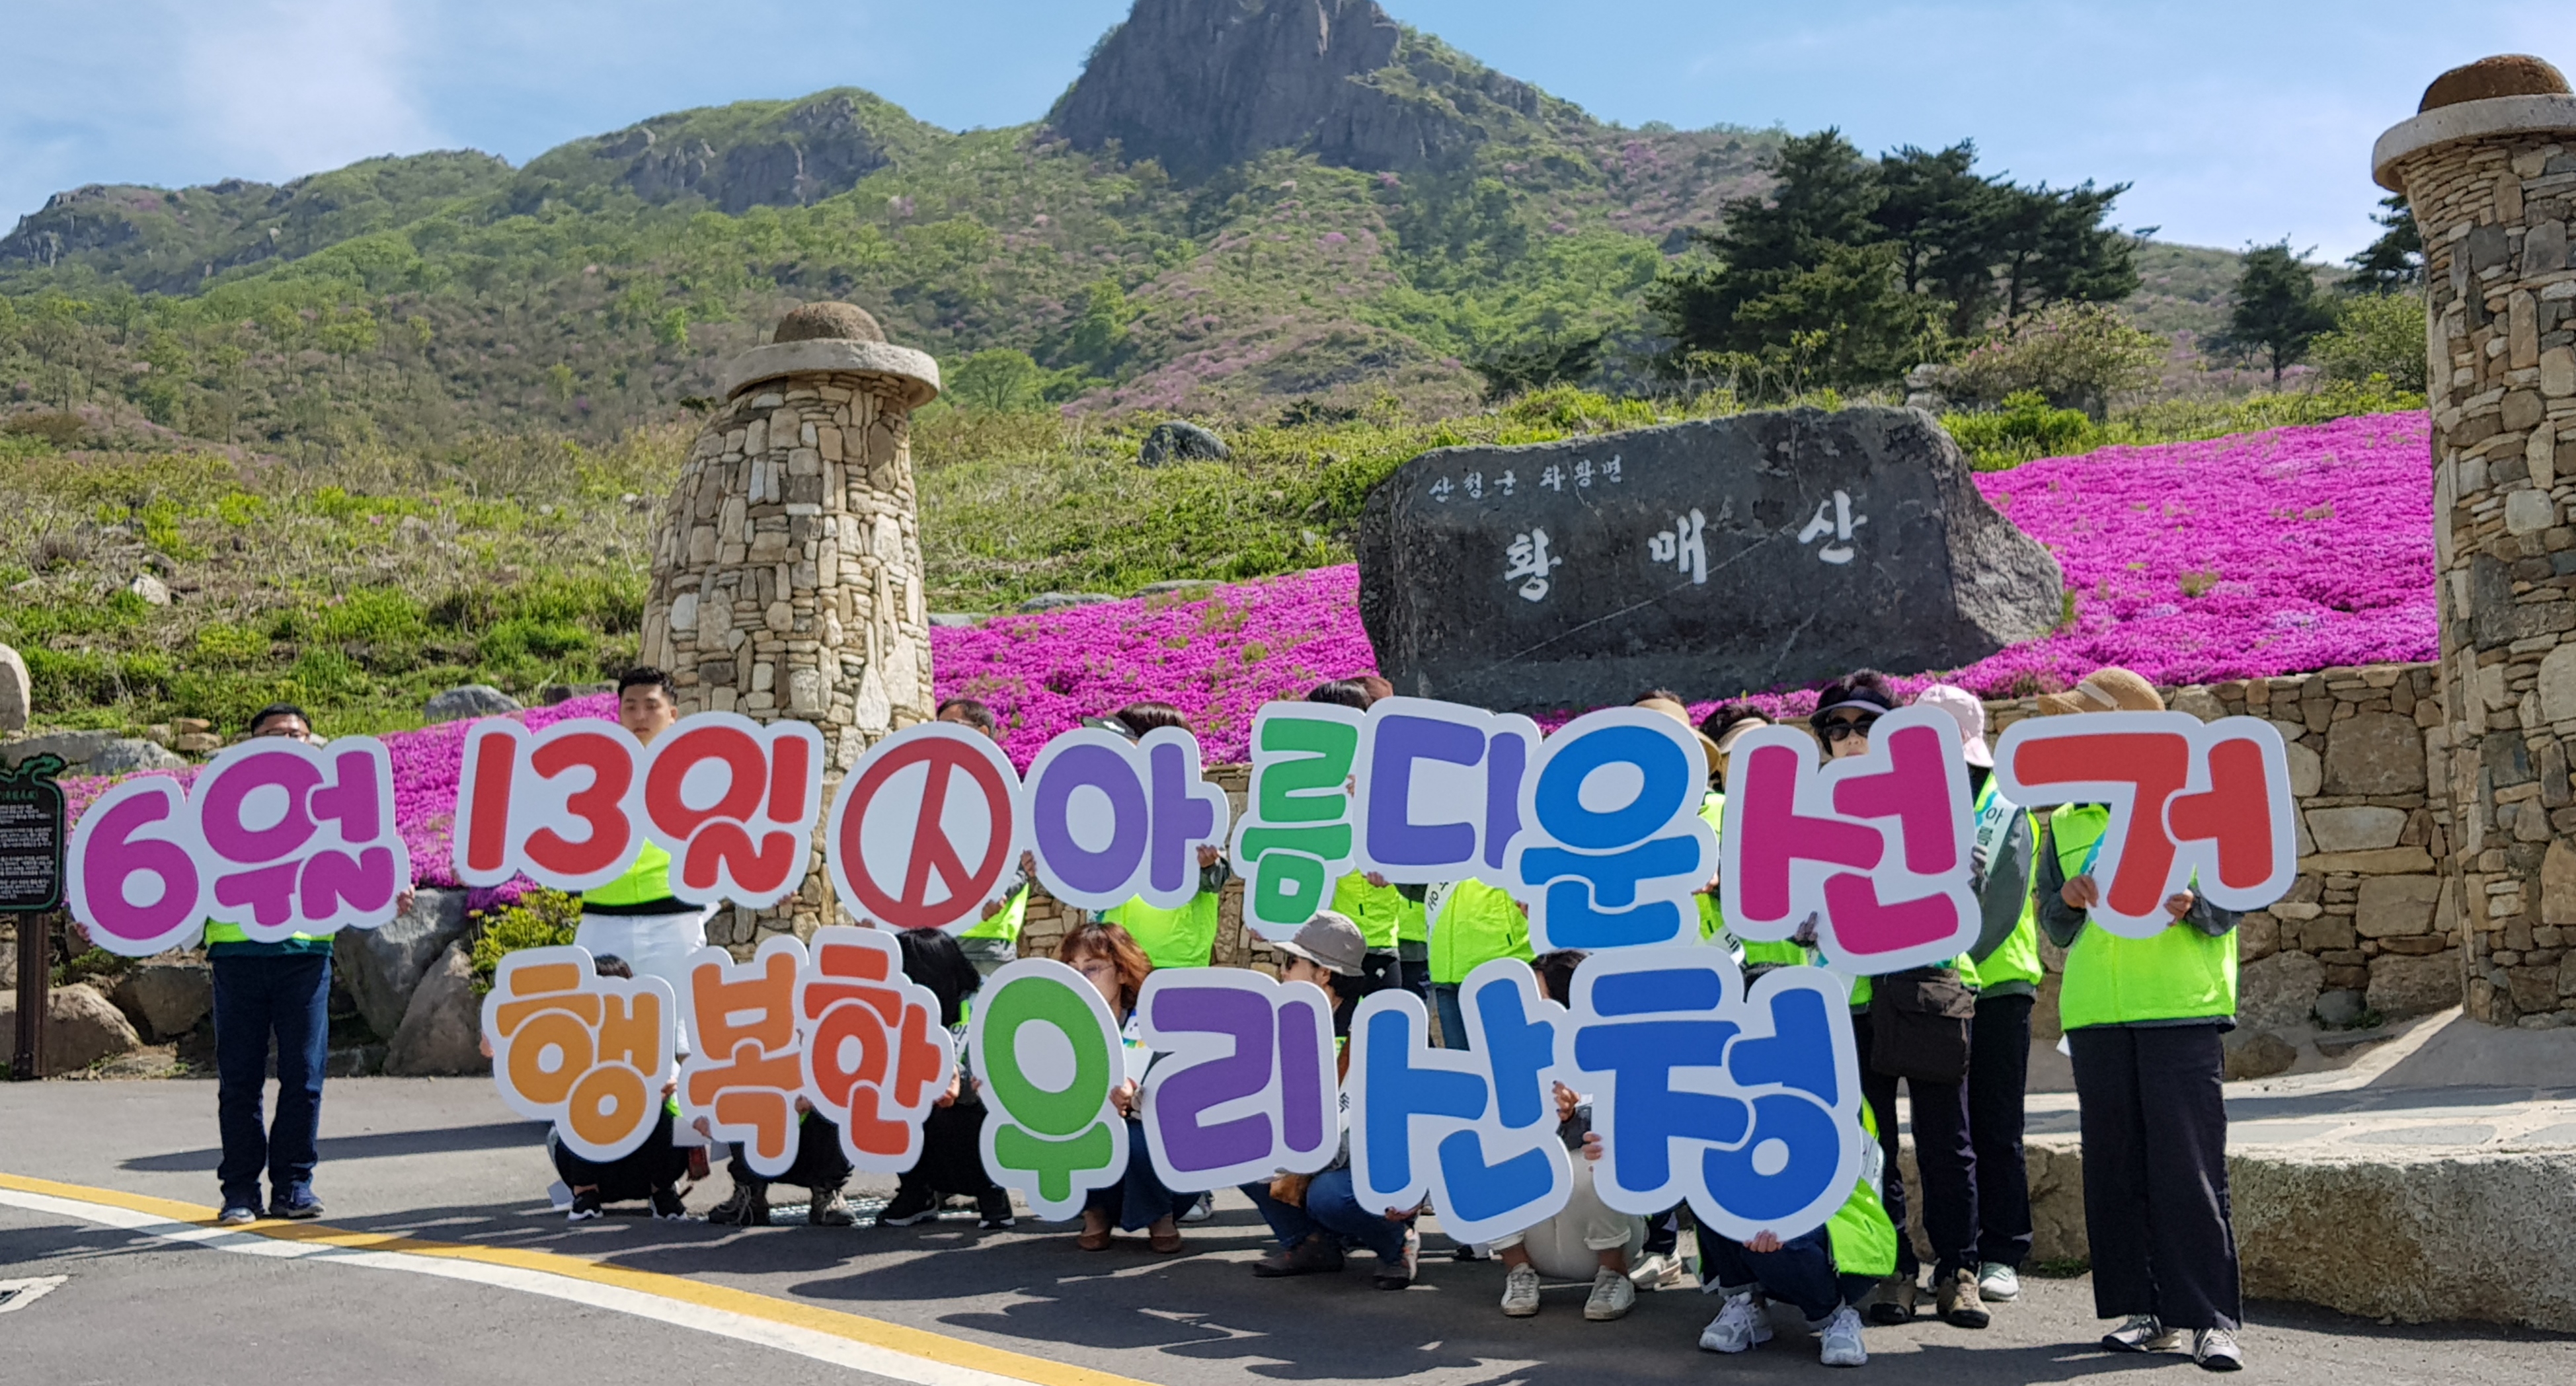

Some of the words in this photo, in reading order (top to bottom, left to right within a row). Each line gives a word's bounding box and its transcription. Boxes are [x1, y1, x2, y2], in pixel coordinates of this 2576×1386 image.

[1428, 469, 1516, 503] 산청군
[1539, 453, 1622, 492] 차황면
[83, 750, 397, 941] 6월
[466, 726, 809, 894] 13일
[1033, 714, 1701, 950] 아름다운
[1740, 726, 2273, 955] 선거
[495, 944, 942, 1159] 행복한
[982, 976, 1323, 1203] 우리
[1365, 968, 1840, 1223] 산청
